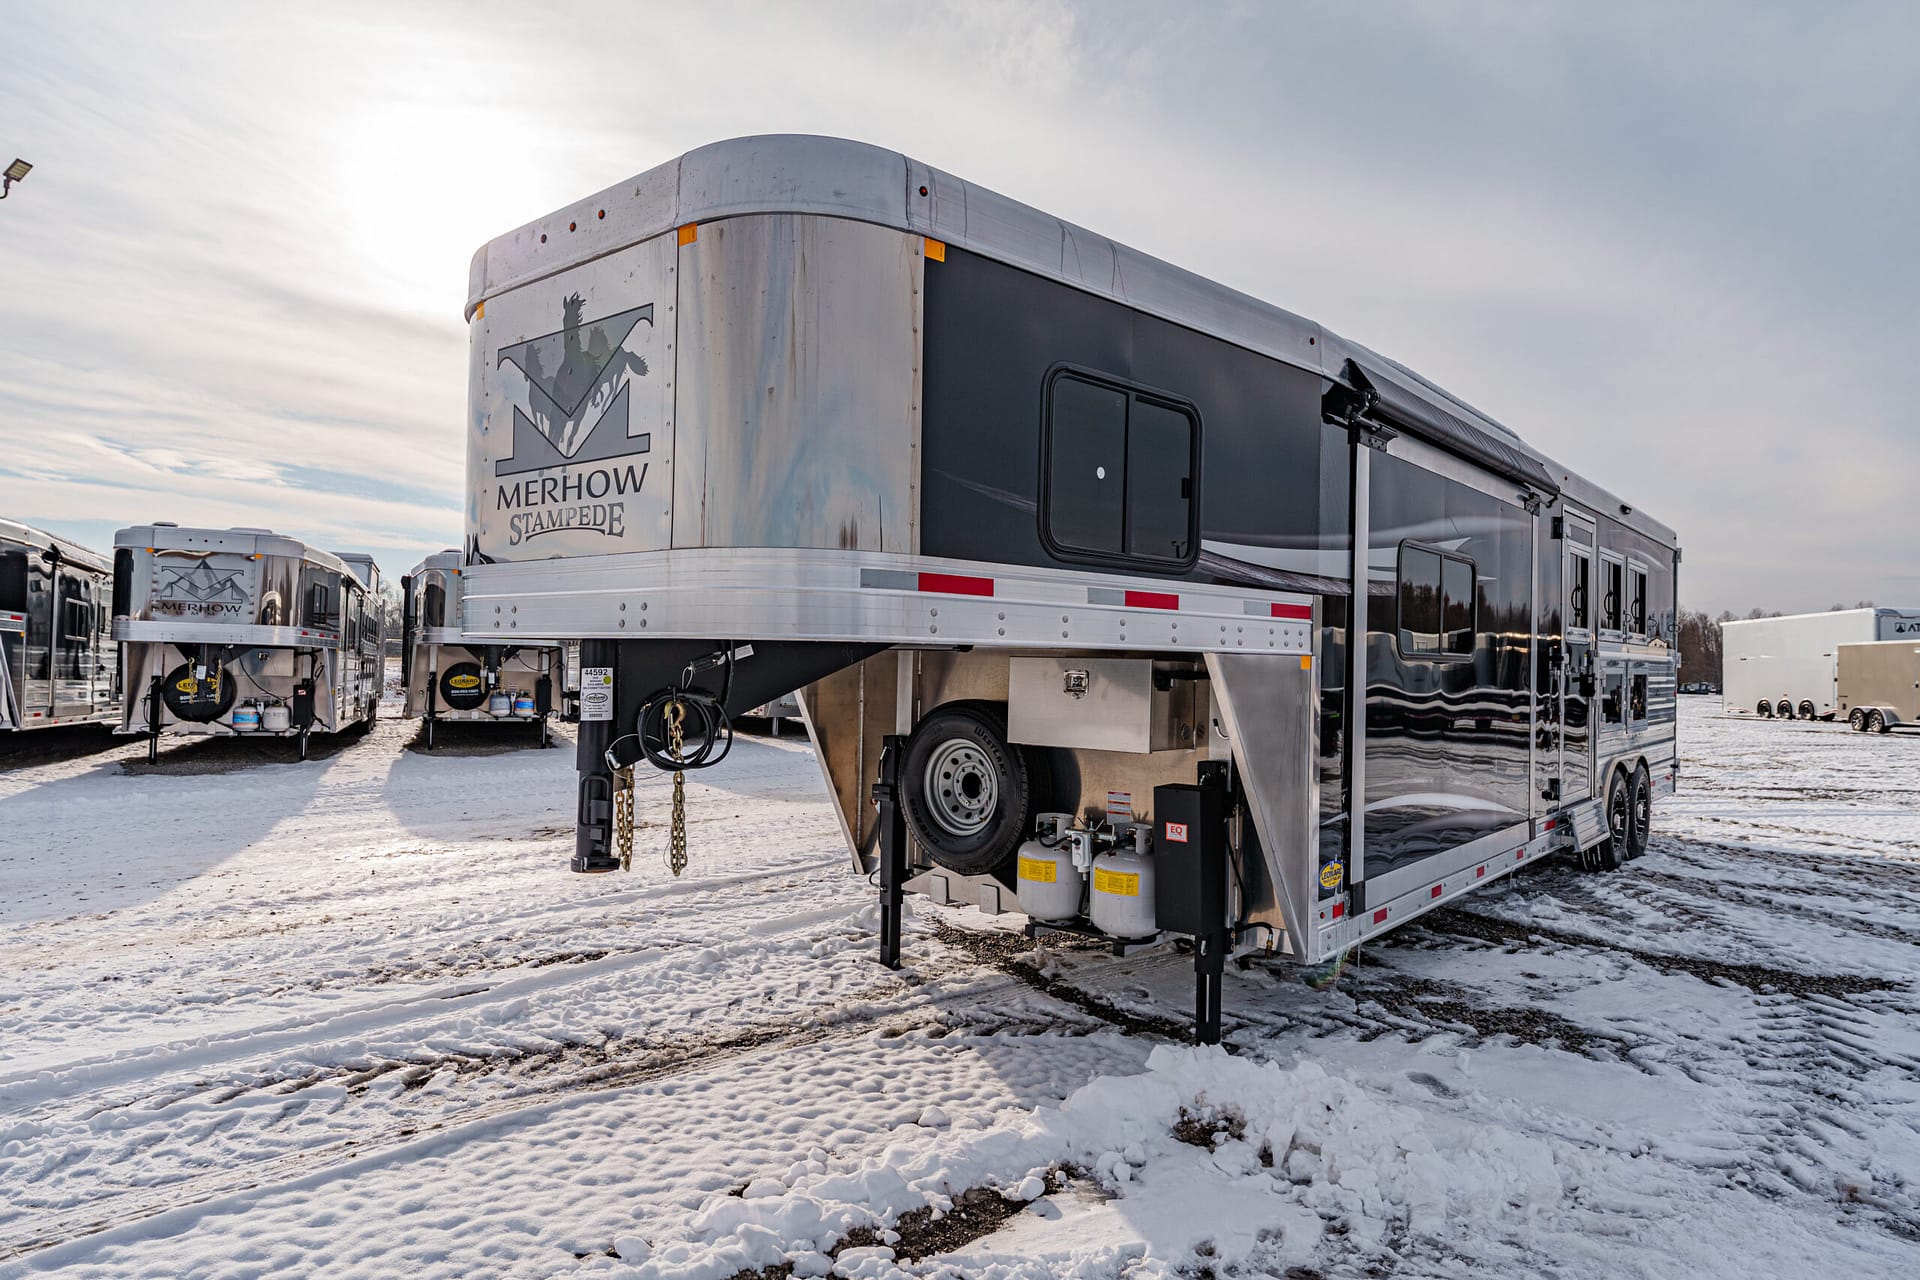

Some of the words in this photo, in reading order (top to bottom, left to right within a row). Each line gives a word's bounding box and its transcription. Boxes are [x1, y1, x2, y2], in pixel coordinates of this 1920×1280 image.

[497, 463, 648, 510] MERHOW
[509, 502, 624, 545] STAMPEDE
[161, 602, 242, 613] MERHOW
[1170, 825, 1183, 837] EQ
